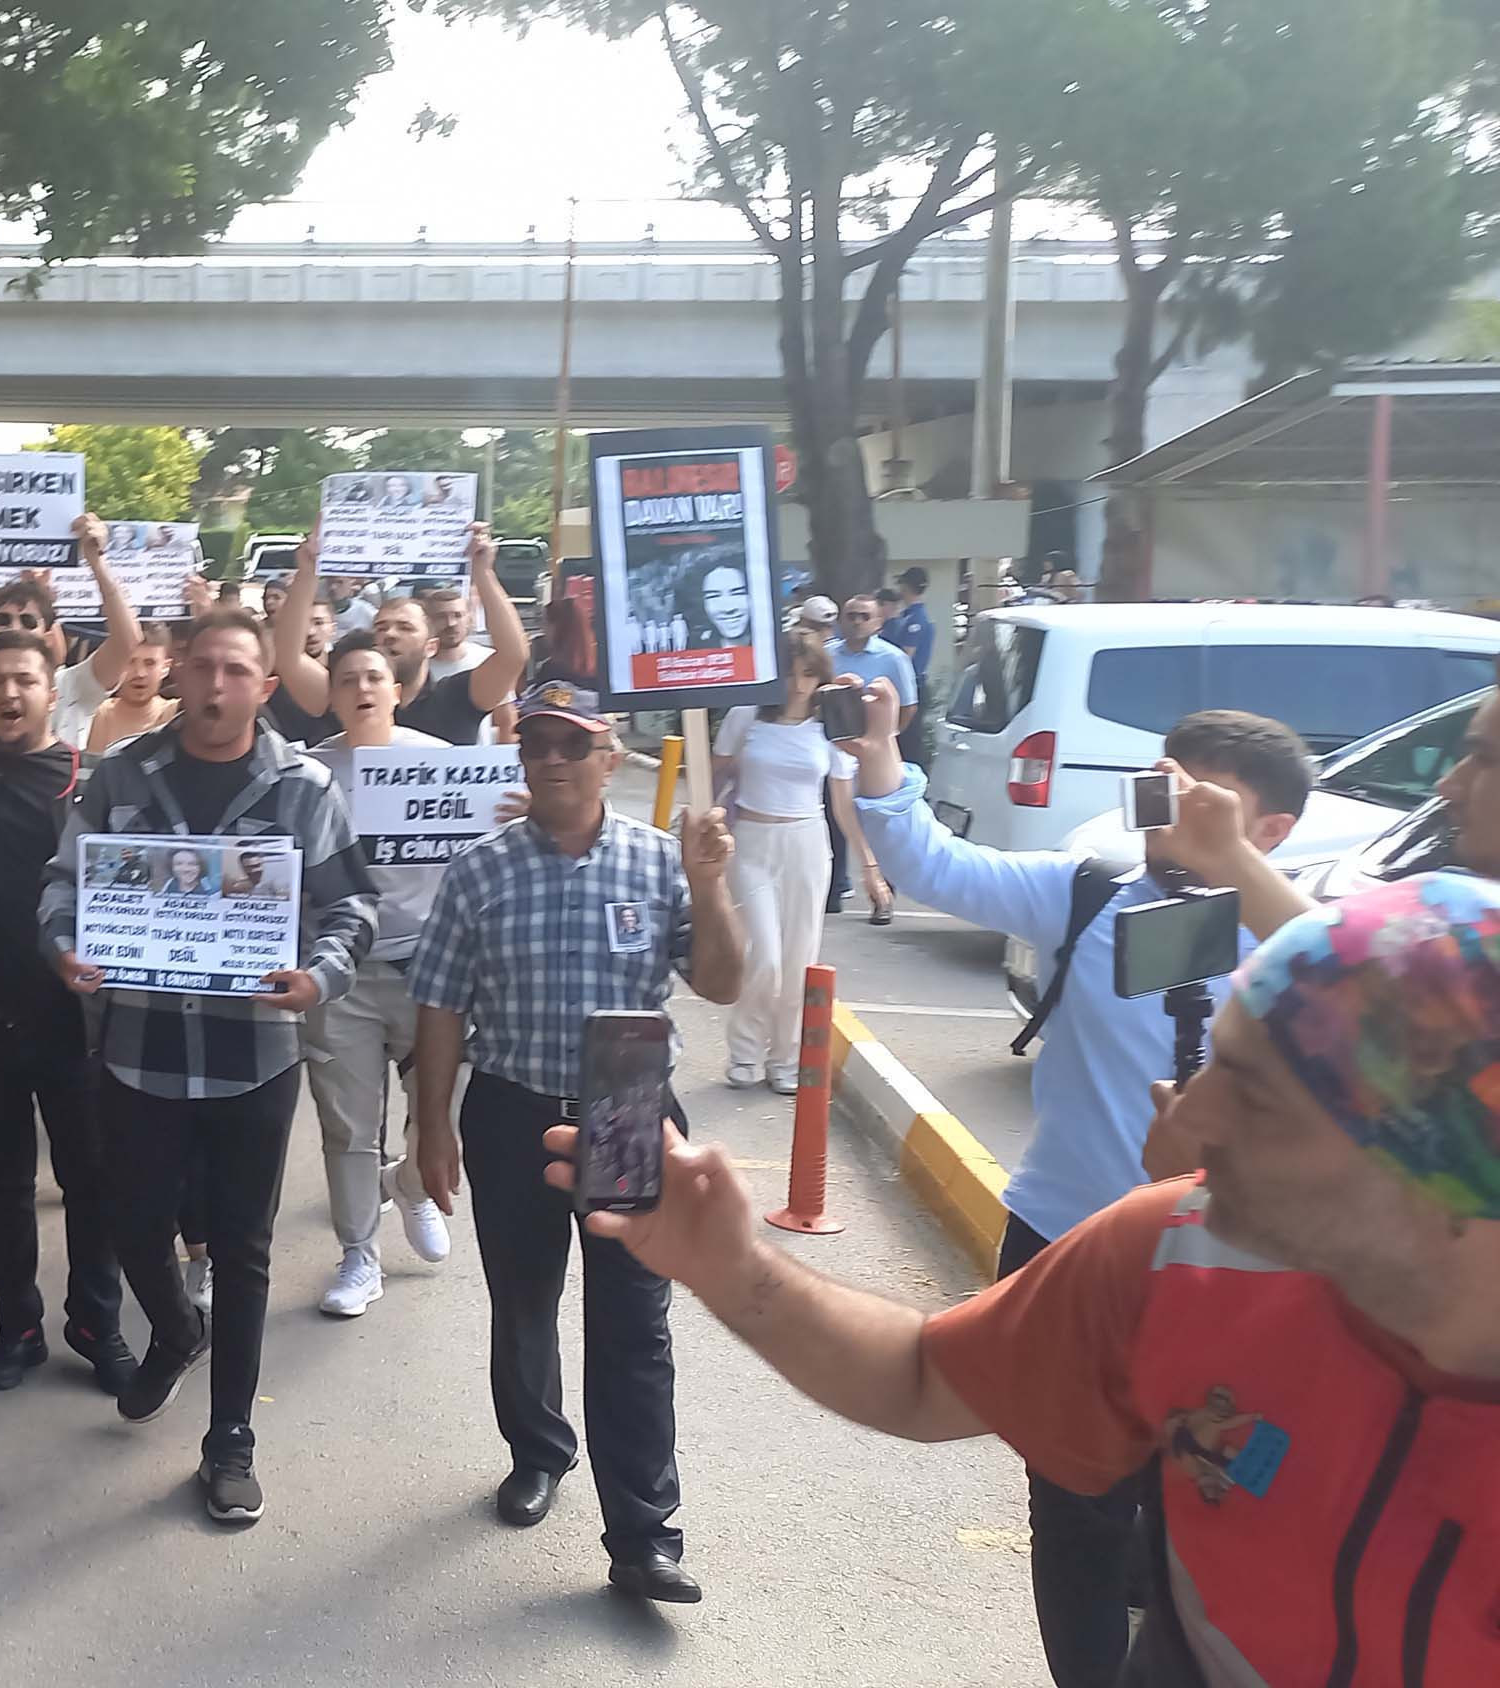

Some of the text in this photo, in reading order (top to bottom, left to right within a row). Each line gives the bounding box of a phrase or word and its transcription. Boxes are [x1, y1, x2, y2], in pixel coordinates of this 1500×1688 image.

[361, 761, 438, 787] TRAFİK
[404, 791, 475, 821] DEĞİL
[374, 836, 397, 863] İŞ
